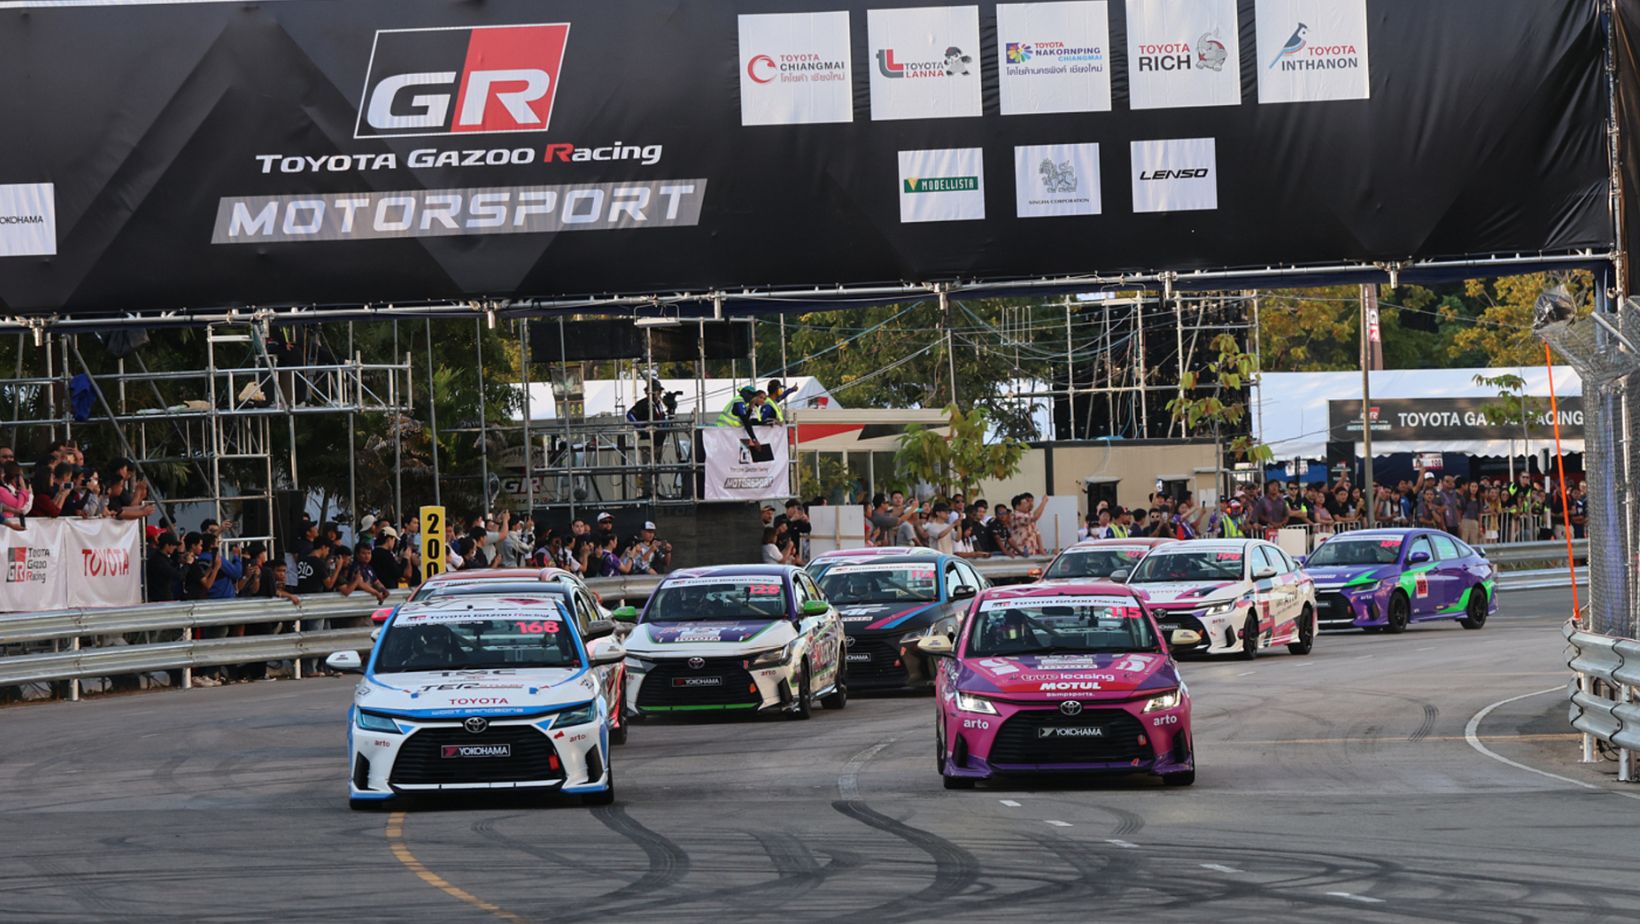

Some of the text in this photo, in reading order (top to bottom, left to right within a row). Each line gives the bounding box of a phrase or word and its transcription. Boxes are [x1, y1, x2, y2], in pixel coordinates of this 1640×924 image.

[1036, 47, 1101, 56] NAKORNPING
[1139, 43, 1190, 54] TOYOTA
[1308, 45, 1356, 56] TOYOTA
[780, 54, 820, 62] TOYOTA
[1139, 55, 1191, 72] RICH
[780, 61, 845, 71] CHIANGMAI
[905, 62, 945, 71] TOYOTA
[1281, 57, 1358, 71] INTHANON
[906, 70, 945, 78] LANNA
[366, 69, 551, 129] GR
[256, 140, 663, 174] TOYOTA GAZOO Racing
[1139, 168, 1208, 181] LENSO
[922, 178, 975, 191] MODELLISTA
[228, 184, 697, 236] MOTORSPORT
[0, 215, 44, 225] OKOHAMA
[1398, 412, 1461, 427] TOYOTA
[82, 548, 129, 576] TOYOTA
[1110, 606, 1143, 618] 115
[515, 621, 560, 634] 168
[1060, 673, 1115, 682] leasing
[1040, 682, 1101, 691] MOTUL
[450, 697, 508, 705] TOYOTA
[963, 719, 989, 730] arto
[1153, 715, 1177, 726] arto
[570, 732, 586, 742] arto
[1055, 728, 1103, 736] YOKOHAMA
[374, 738, 390, 747] arto
[458, 745, 508, 755] YOKOHAMA
